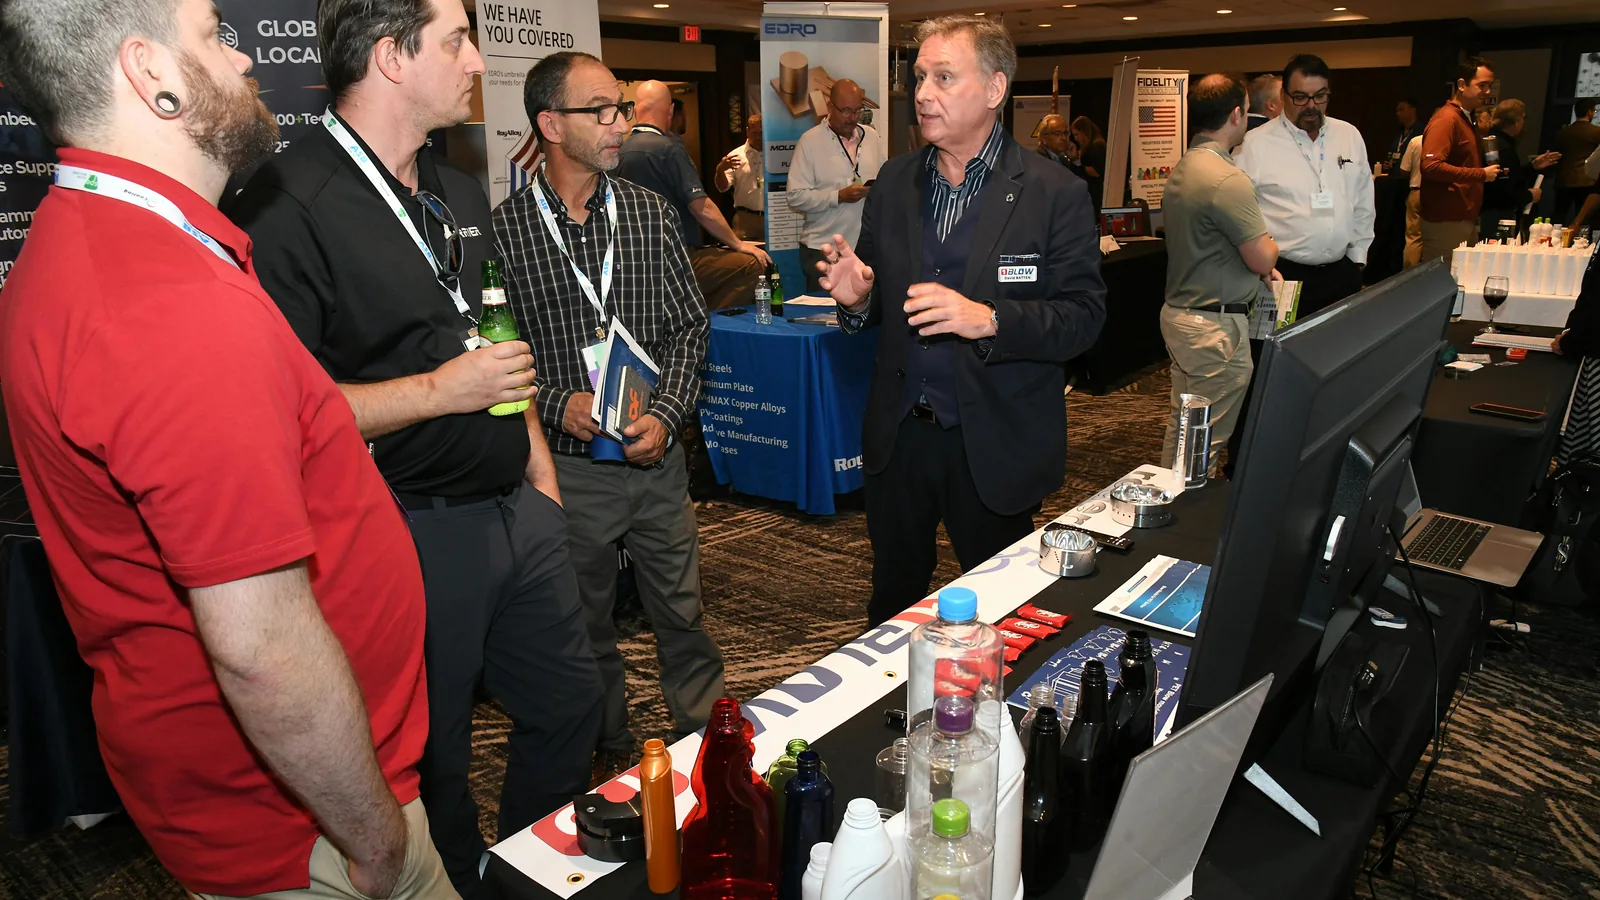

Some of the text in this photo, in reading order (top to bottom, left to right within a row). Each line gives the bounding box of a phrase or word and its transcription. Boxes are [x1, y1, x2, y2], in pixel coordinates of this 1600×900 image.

[483, 2, 542, 26] WE HAVE
[257, 19, 317, 37] GLOB
[685, 26, 699, 41] EXIT
[765, 23, 817, 37] EDRO
[485, 24, 574, 49] YOU COVERED
[1137, 77, 1178, 87] FIDELITY
[708, 362, 732, 374] Steels
[702, 379, 754, 393] minum Plate
[731, 397, 759, 411] Copper
[760, 402, 787, 415] Alloys
[727, 430, 789, 449] Manufacturing
